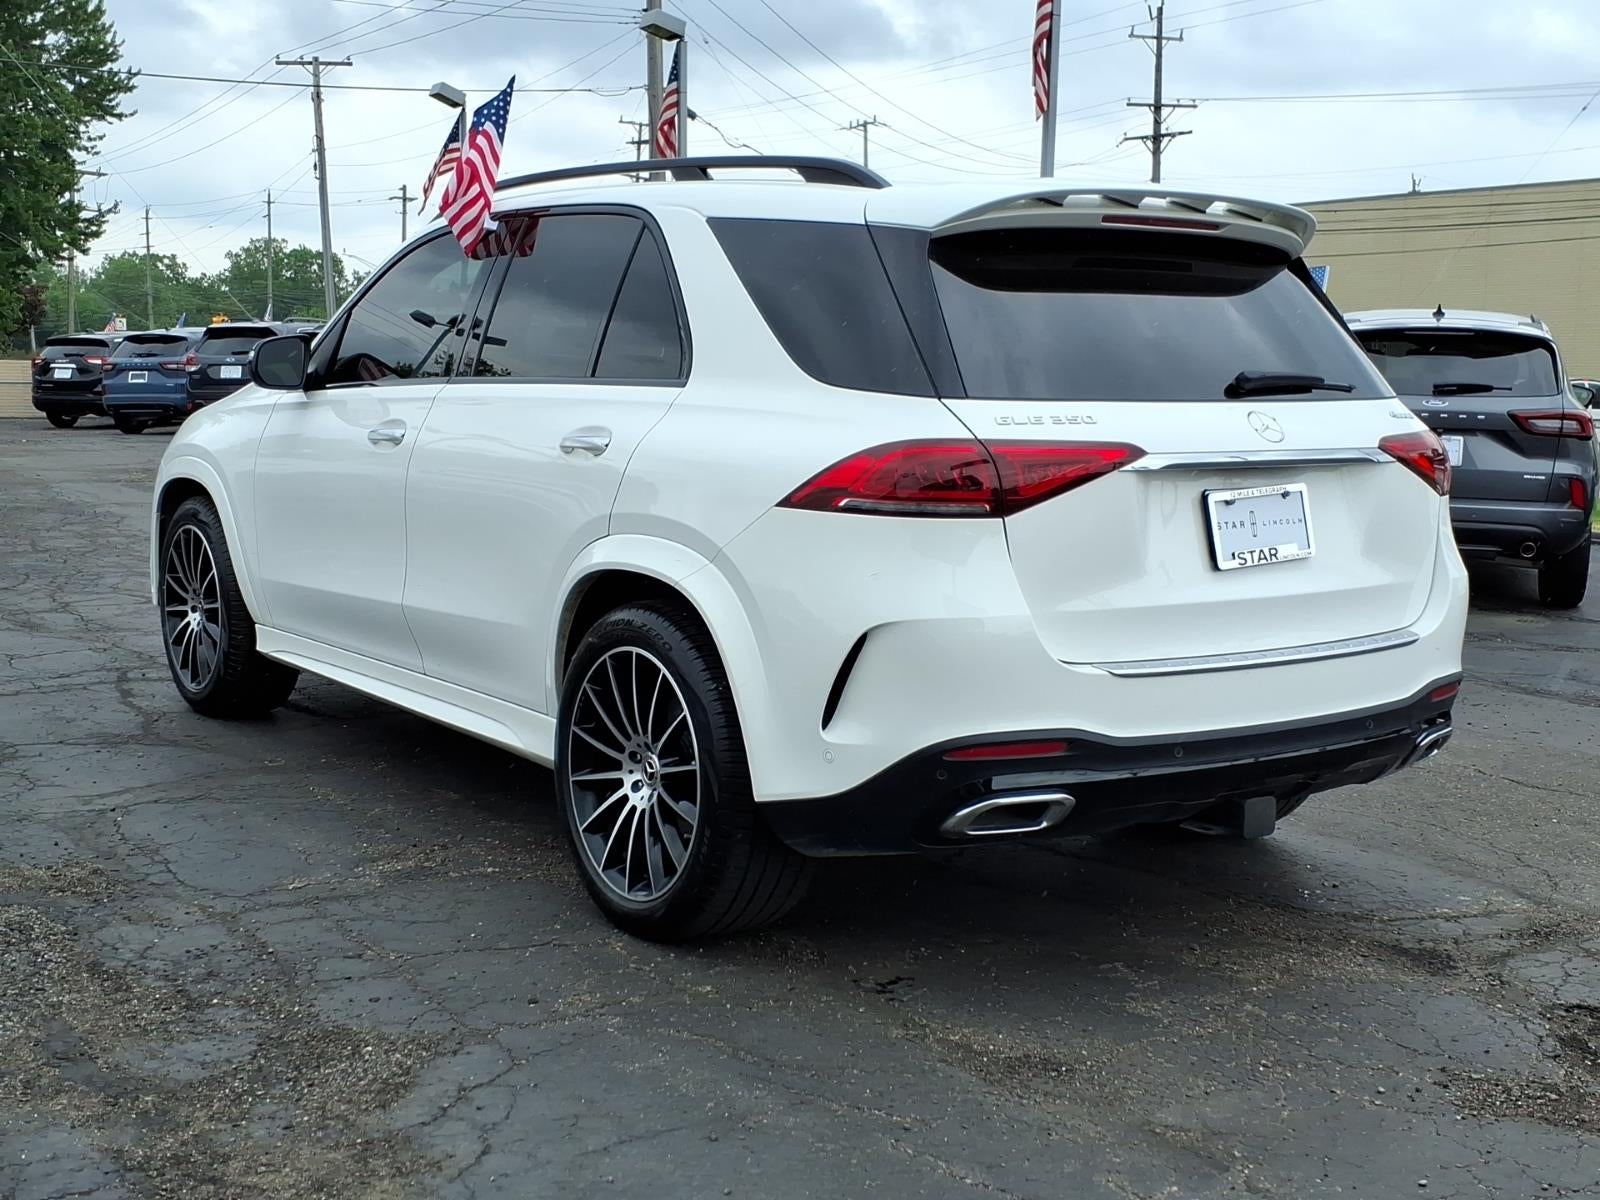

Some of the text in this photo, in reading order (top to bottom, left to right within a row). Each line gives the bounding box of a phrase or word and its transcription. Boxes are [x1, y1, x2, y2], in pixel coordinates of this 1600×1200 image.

[994, 415, 1098, 426] GLE 350
[1237, 490, 1249, 498] MILE
[1256, 486, 1287, 495] TELEGRAPH
[1217, 518, 1303, 531] STAR LINCOLN
[1237, 547, 1280, 566] STAR
